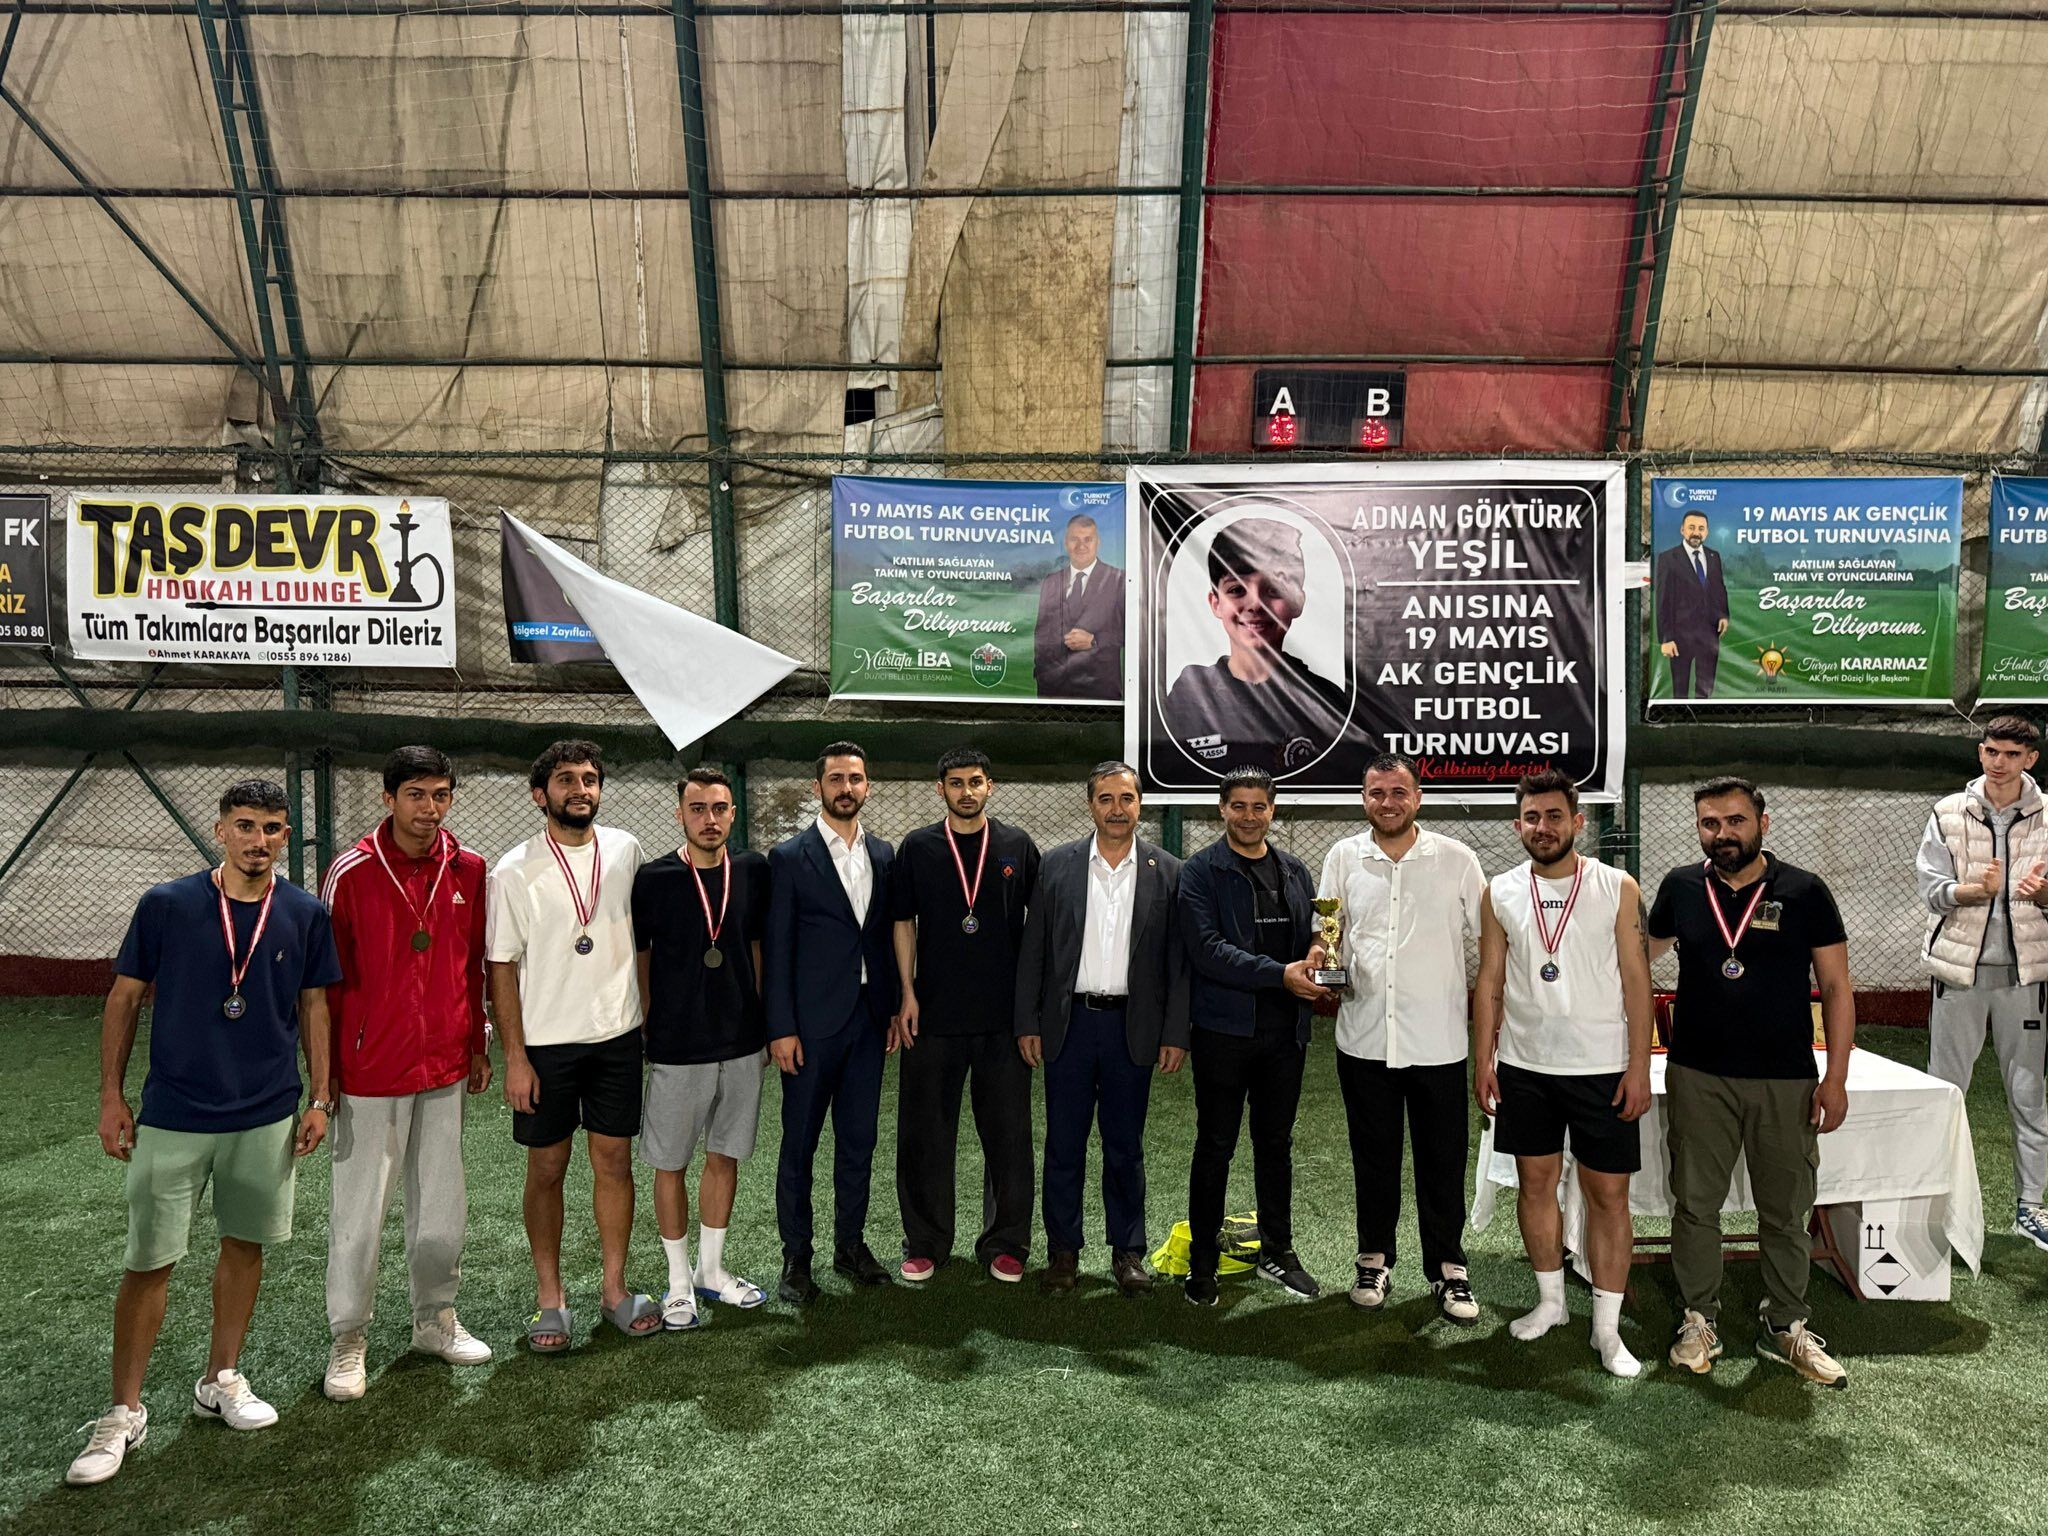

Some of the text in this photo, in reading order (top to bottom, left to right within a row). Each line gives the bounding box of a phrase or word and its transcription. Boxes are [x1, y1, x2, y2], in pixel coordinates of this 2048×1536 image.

[1269, 386, 1296, 415] A
[1366, 388, 1391, 416] B
[850, 502, 1051, 526] 19 MAYIS AK GENÇLİK
[1351, 498, 1582, 530] ADNAN GÖKTÜRK
[1743, 502, 1949, 525] 19 MAYIS AK GENÇLİK
[2007, 506, 2029, 521] 19
[4, 518, 40, 546] FK
[844, 524, 1055, 545] FUTBOL TURNUVASINA
[1737, 528, 1952, 544] FUTBOL TURNUVASINA
[2000, 528, 2048, 543] FUTB
[893, 555, 994, 568] KATILIM SAĞLAYAN
[1407, 532, 1528, 577] YEŞİL
[1792, 557, 1896, 569] KATILIM SAĞLAYAN
[874, 568, 1012, 581] TAKIM VE OYUNCULARINA
[1773, 572, 1914, 582] TAKIM VE OYUNCULARINA
[147, 579, 362, 603] HOOKAH LOUNGE
[850, 582, 957, 612] Başarılar
[1758, 586, 1867, 617] Başarılar
[1401, 594, 1554, 619] ANISINA
[14, 625, 27, 637] 80
[30, 625, 44, 638] 80
[81, 613, 442, 651] Tüm Takımlara Başarılar Dileriz
[903, 608, 1017, 639] Diliyorum.
[1811, 612, 1927, 642] Diliyorum.
[1405, 626, 1549, 649] 19 MAYIS
[157, 650, 250, 660] Ahmet KARAKAYA
[266, 652, 351, 663] (0555 896 1286)
[917, 648, 952, 668] İBA
[1840, 657, 1928, 670] KARARMAZ
[1376, 656, 1578, 689] AK GENÇLİK
[1808, 674, 1821, 682] AK
[1822, 674, 1839, 682] Parti
[1986, 673, 1998, 681] AK
[1999, 673, 2016, 681] Parti
[1414, 697, 1541, 720] FUTBOL
[1383, 731, 1569, 755] TURNUVASI
